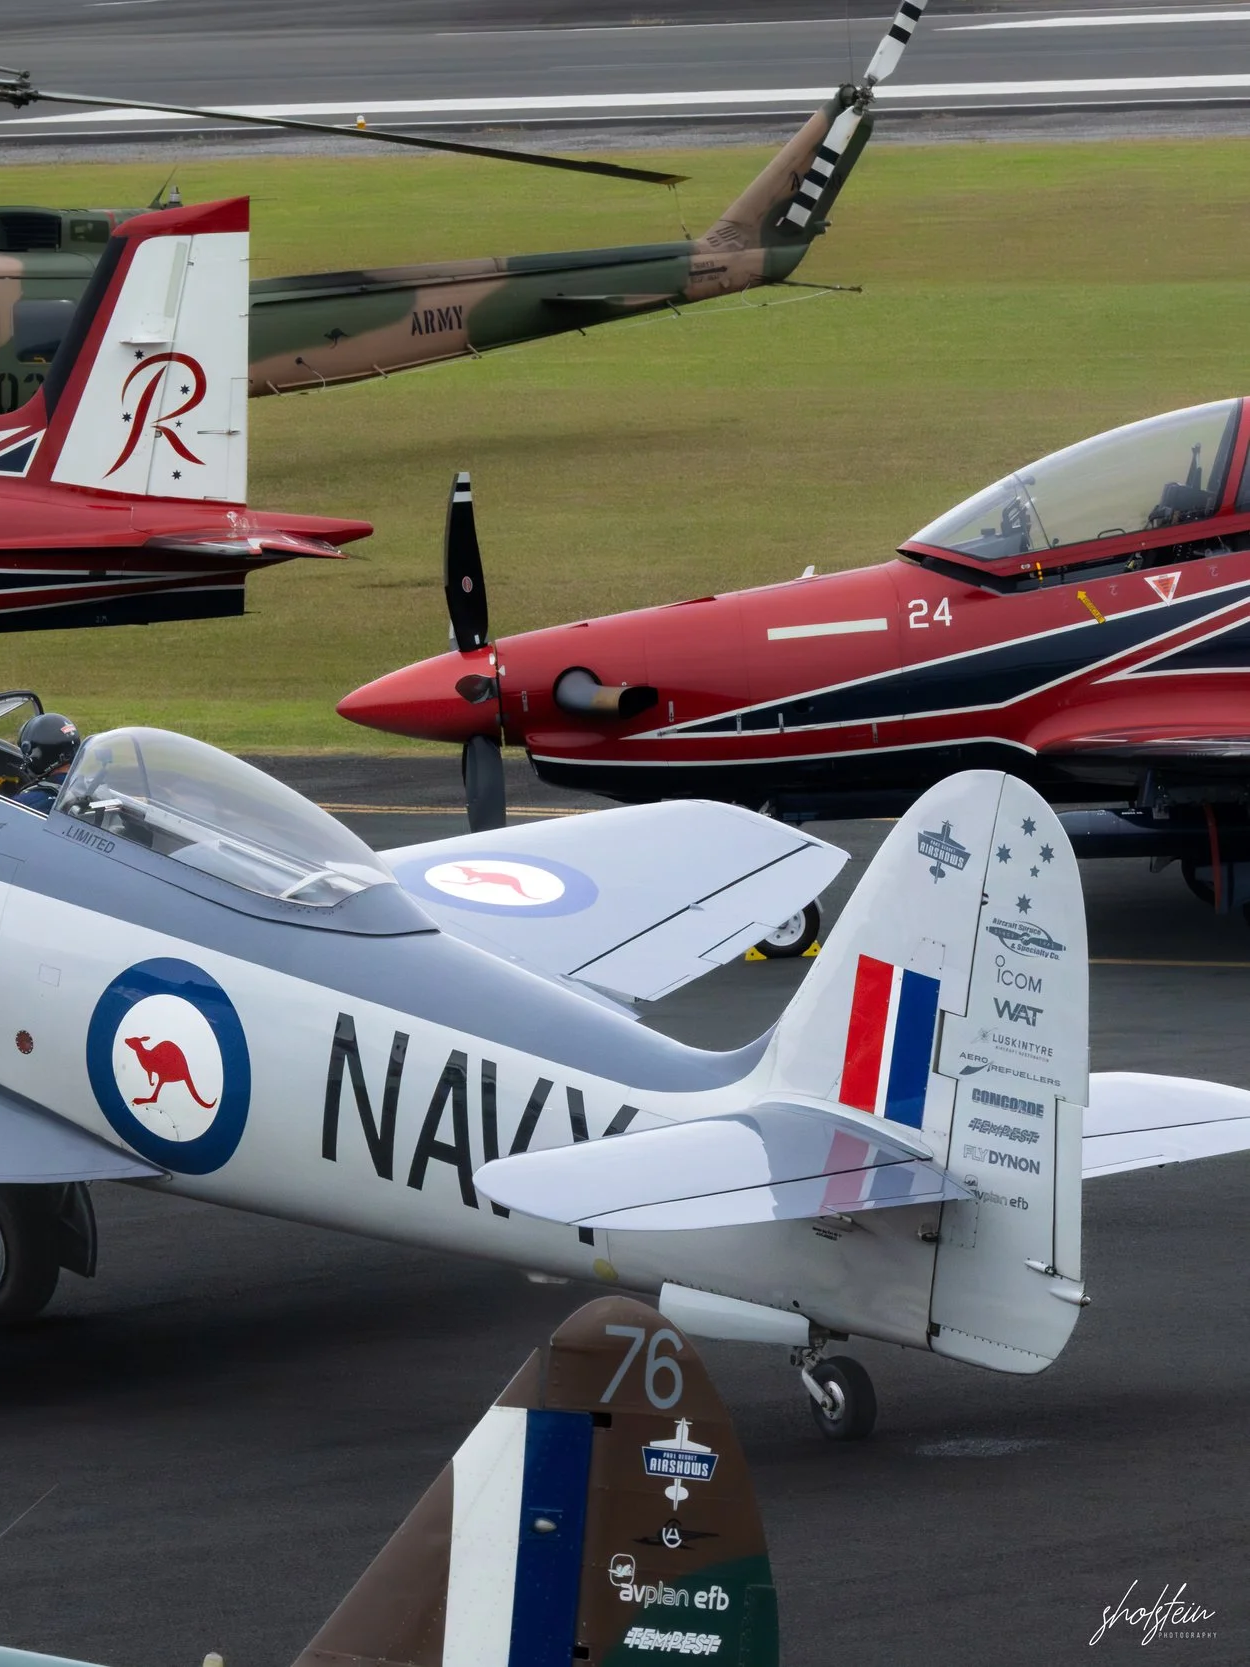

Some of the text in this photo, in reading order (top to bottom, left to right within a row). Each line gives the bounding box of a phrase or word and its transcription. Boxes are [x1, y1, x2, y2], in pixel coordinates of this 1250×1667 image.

[411, 305, 463, 336] ARMY
[908, 597, 953, 629] 24
[920, 841, 965, 869] AIRSHOWS
[992, 917, 1042, 936] Aircraft Spruce
[1017, 943, 1050, 959] Specialty
[993, 997, 1044, 1027] WAT
[959, 1051, 989, 1064] AERO
[992, 1033, 1054, 1058] LUSKINTYRE
[991, 1064, 1062, 1087] REFUELLERS
[971, 1088, 1045, 1118] CONCORDE
[968, 1117, 1040, 1145] TEMPEST
[1009, 1196, 1029, 1210] efb
[600, 1324, 684, 1410] 76
[650, 1457, 709, 1477] AIRSHOWS
[619, 1580, 730, 1611] avplan efb
[623, 1627, 722, 1656] TEMPEST
